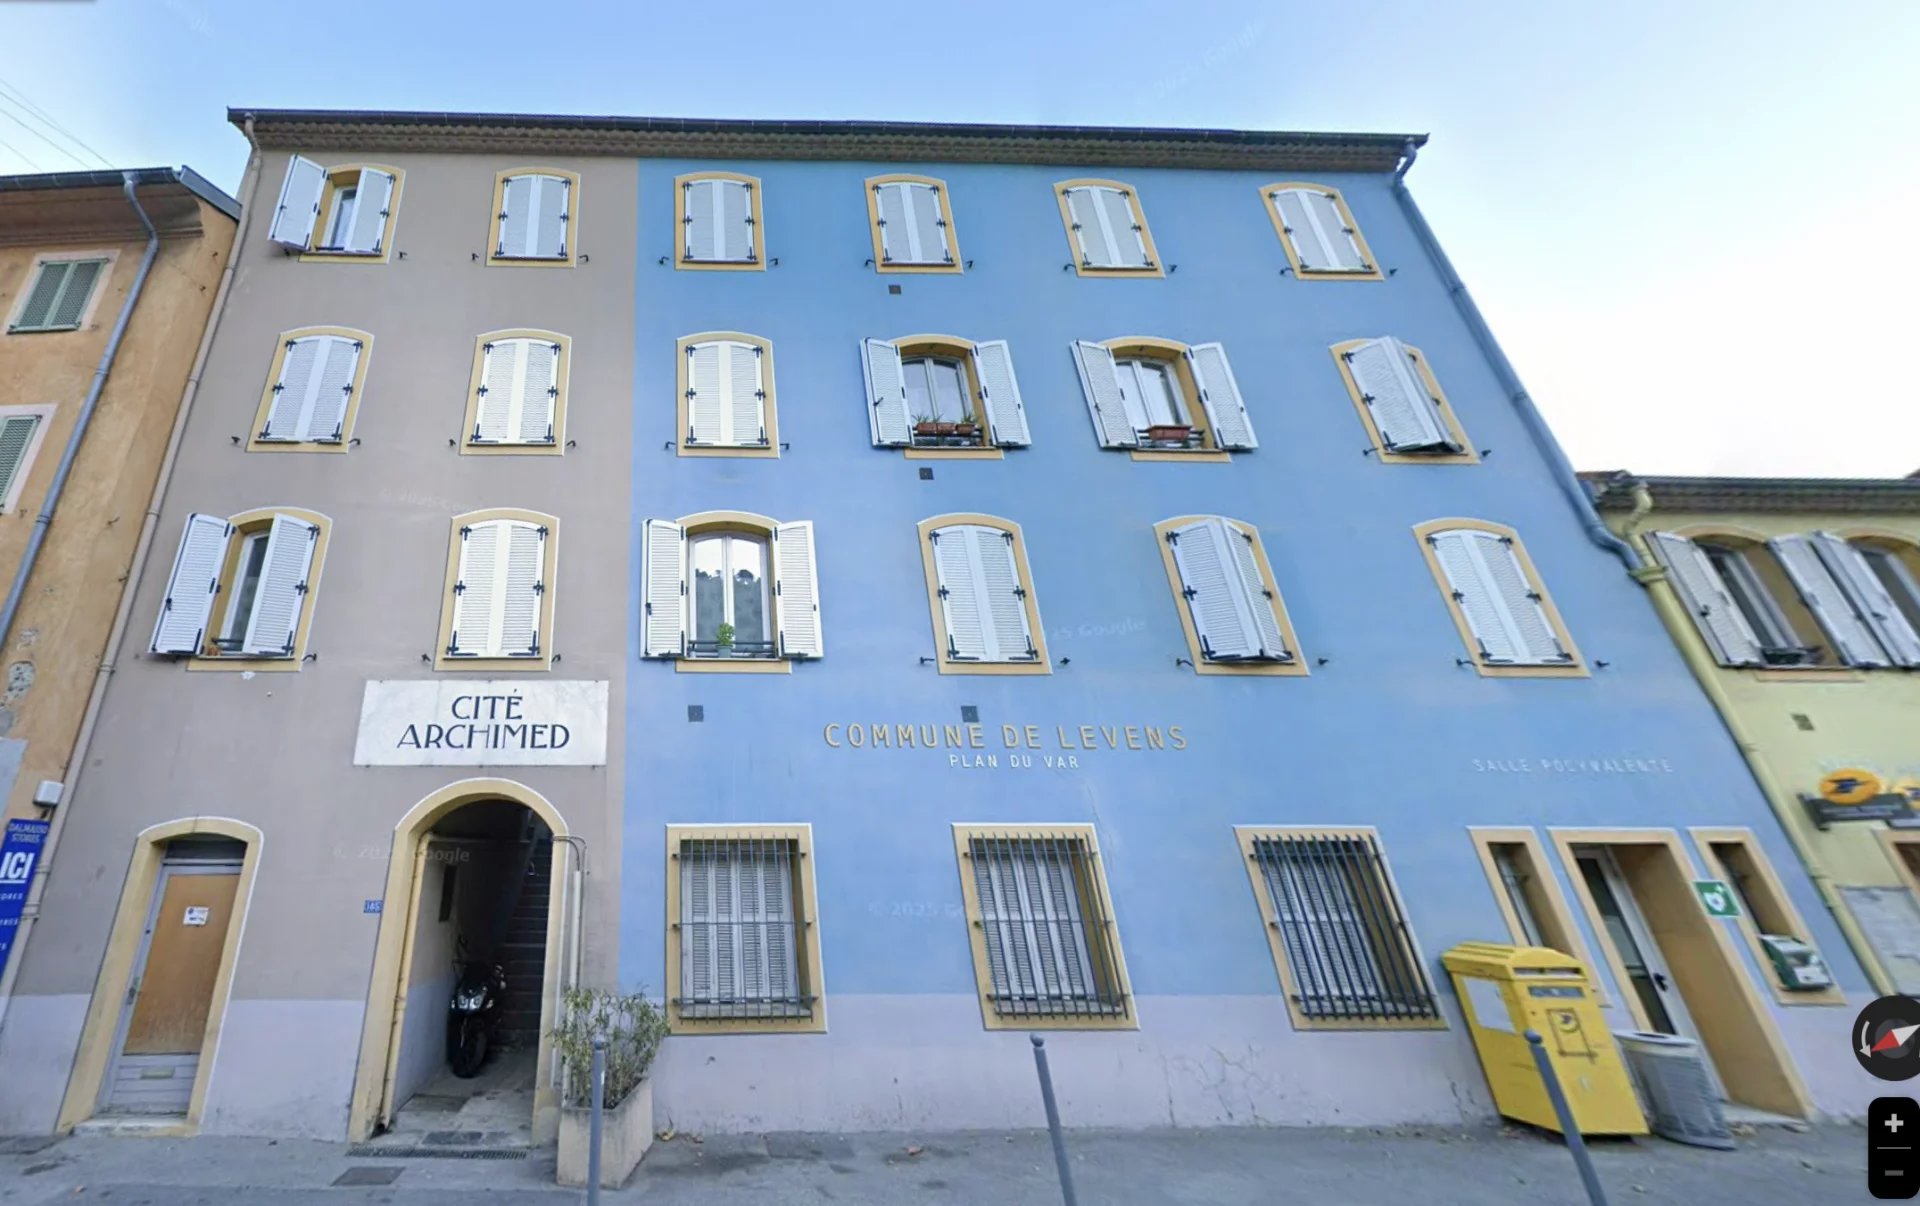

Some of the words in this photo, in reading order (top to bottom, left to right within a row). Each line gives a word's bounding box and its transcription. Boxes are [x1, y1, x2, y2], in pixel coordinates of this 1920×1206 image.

[451, 688, 523, 720] CITÉ
[396, 723, 570, 749] ARCHIMED
[823, 722, 986, 749] COMMUNE
[1001, 724, 1041, 749] DE
[1059, 725, 1188, 751] LEVENS
[949, 754, 999, 769] PLAN
[1010, 755, 1032, 769] DU
[1043, 755, 1080, 770] VAR
[1471, 758, 1532, 773] SALLE
[0, 851, 35, 880] ICI
